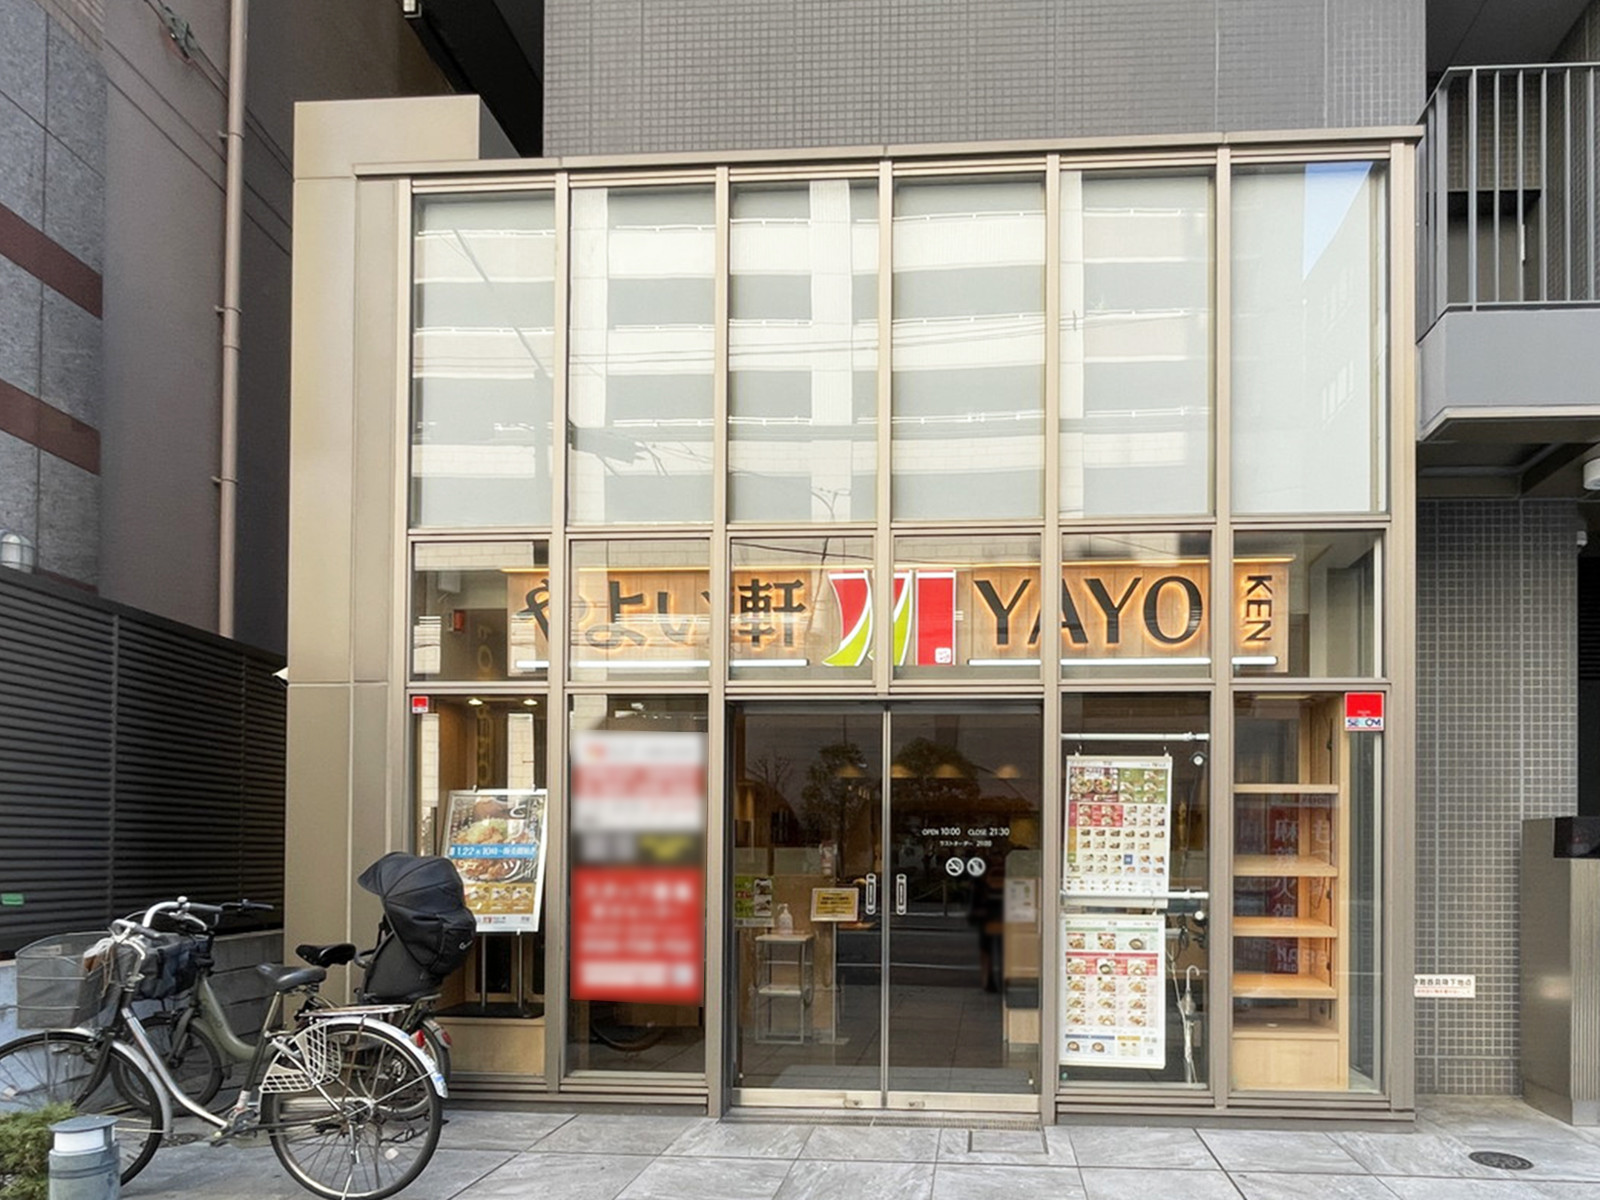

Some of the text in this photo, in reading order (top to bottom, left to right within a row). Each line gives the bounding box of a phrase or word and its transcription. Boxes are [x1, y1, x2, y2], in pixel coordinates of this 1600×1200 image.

[1245, 574, 1272, 643] KEN
[921, 827, 1010, 836] OPEN 10:00 CLOSE 21:30
[1414, 978, 1472, 986] 難器具降下地点
